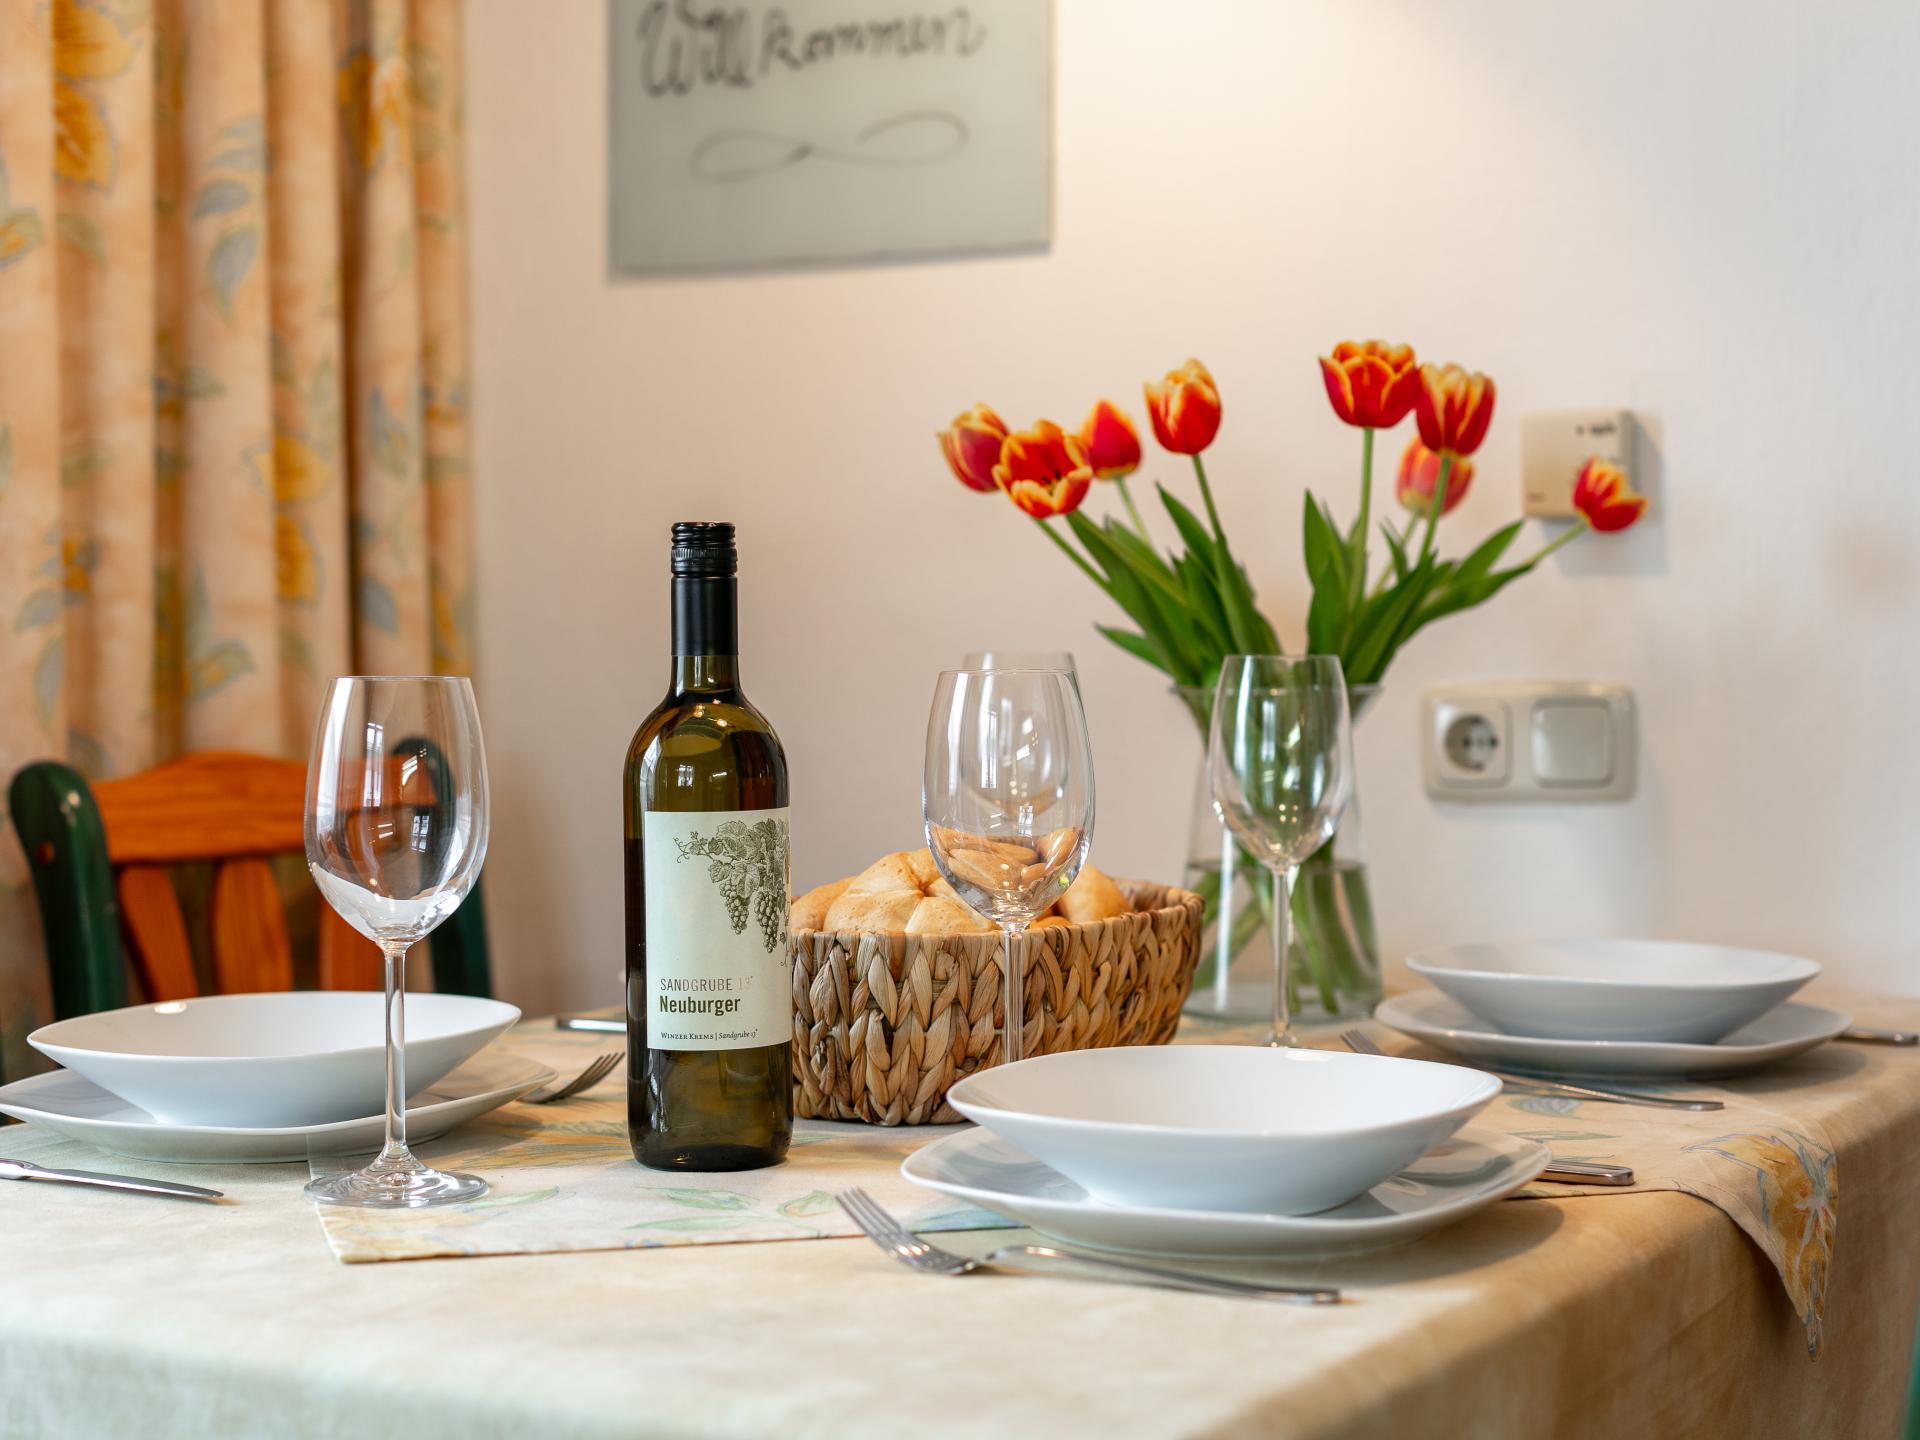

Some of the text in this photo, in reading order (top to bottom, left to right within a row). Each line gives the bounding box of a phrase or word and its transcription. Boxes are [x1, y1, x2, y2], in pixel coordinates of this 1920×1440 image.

[636, 0, 988, 97] Willkommen
[660, 978, 733, 992] SANDGRUBE
[660, 995, 741, 1017] Neuburger
